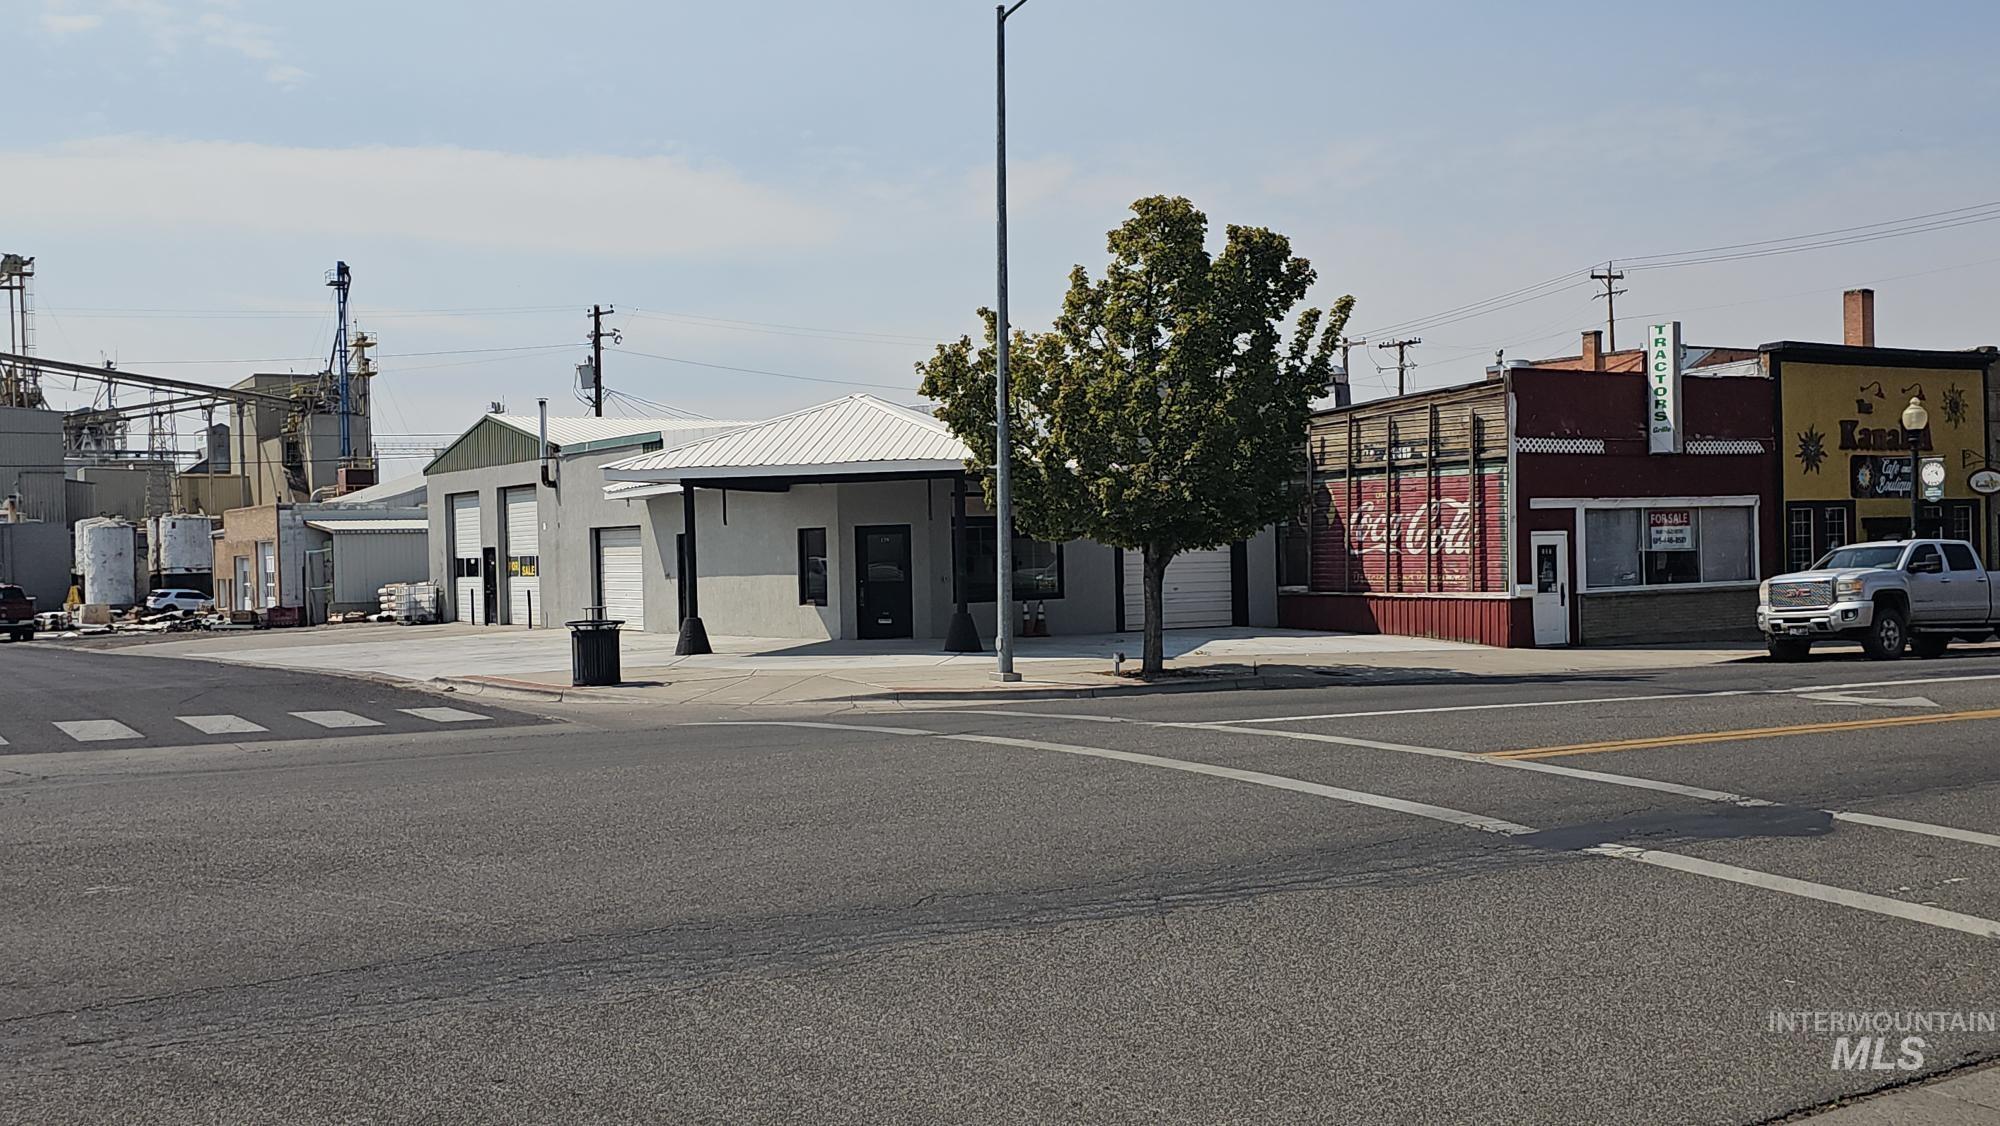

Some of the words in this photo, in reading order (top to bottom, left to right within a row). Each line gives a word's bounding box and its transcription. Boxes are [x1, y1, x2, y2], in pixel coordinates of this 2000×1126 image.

[1654, 325, 1667, 421] TRACTORS
[1875, 476, 1912, 496] Boutiqu
[1650, 513, 1667, 524] FOR
[1668, 512, 1688, 524] SALE
[522, 565, 535, 576] SALE
